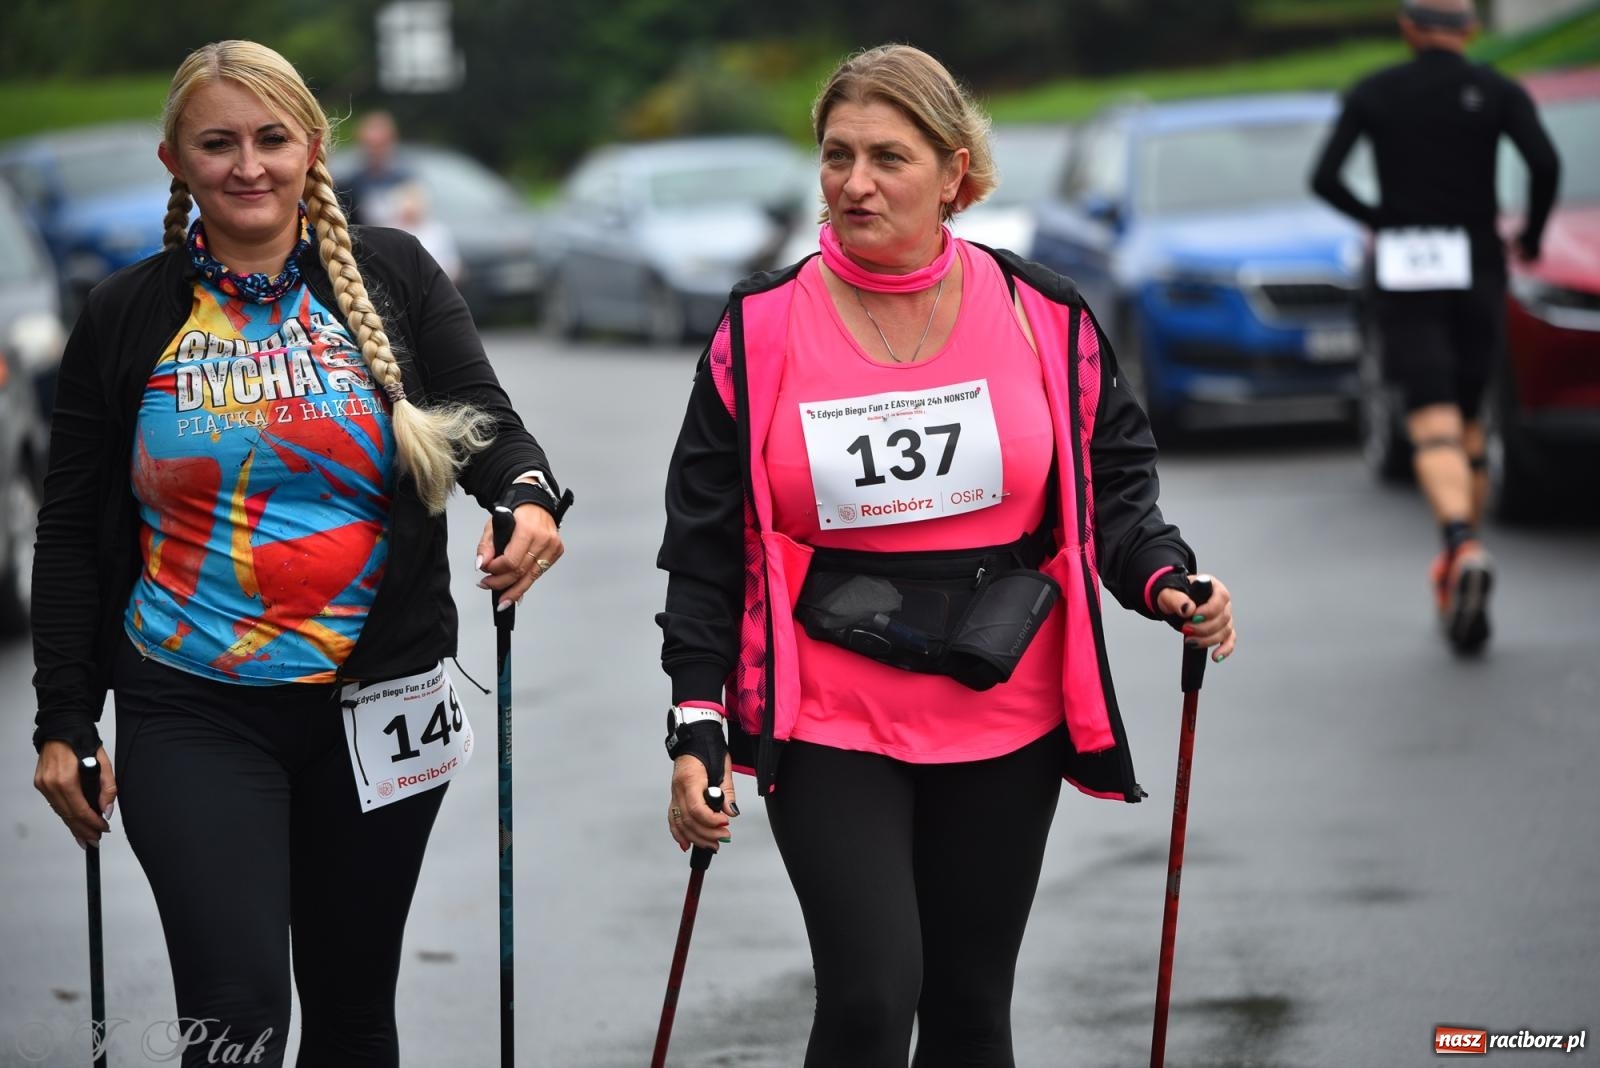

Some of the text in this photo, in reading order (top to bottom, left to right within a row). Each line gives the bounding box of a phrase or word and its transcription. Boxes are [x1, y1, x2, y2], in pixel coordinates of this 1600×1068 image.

[176, 348, 327, 413] DYCHA
[177, 397, 386, 437] PIĄTKA Z HAKIEM
[810, 410, 816, 420] 5
[817, 407, 843, 420] Edycja
[844, 405, 867, 417] Biegu
[868, 403, 883, 414] Fun
[884, 403, 889, 411] z
[890, 398, 926, 410] EASYRUN
[927, 396, 942, 407] 24h
[944, 390, 979, 405] NONSTOP
[846, 423, 961, 487] 137
[861, 488, 984, 517] Racibórz OSiR
[356, 691, 381, 705] Edycja
[382, 687, 404, 699] Biegu
[405, 683, 419, 695] Fun
[383, 683, 463, 763] 148
[397, 757, 459, 789] Racibórz
